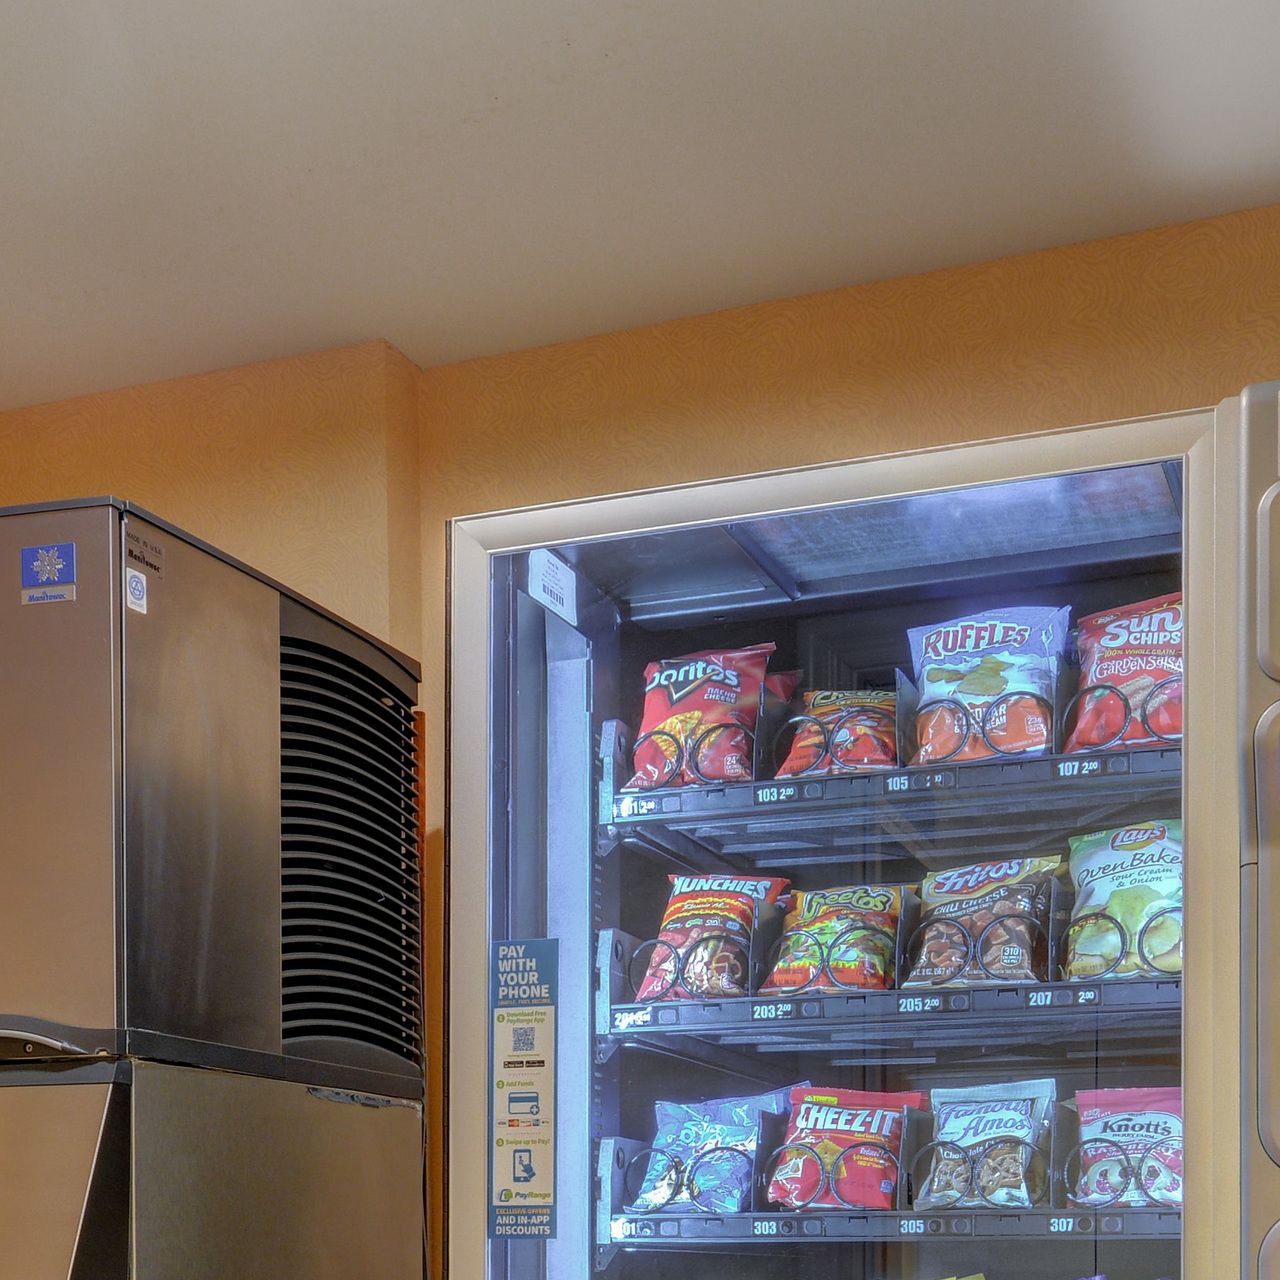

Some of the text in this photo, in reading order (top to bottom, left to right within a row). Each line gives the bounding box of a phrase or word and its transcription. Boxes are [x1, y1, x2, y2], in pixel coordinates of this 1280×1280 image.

[923, 620, 1031, 660] RUFFLES
[1128, 631, 1181, 645] CHIPS
[1057, 761, 1098, 776] 107 2.00
[886, 777, 908, 790] 105
[757, 787, 794, 802] 103 2.00
[1129, 848, 1182, 868] Bake
[934, 858, 1026, 894] Fritos
[1129, 876, 1163, 885] Onion
[933, 887, 1009, 915] CHILI CHEESE
[498, 945, 526, 958] PAY
[498, 958, 536, 972] WITH
[498, 972, 539, 985] YOUR
[498, 985, 550, 999] PHONE
[1029, 991, 1095, 1006] 207 2.00
[753, 1003, 792, 1019] 203 2.00
[899, 998, 940, 1012] 205 2.00
[796, 1103, 901, 1137] CHEEZ-IT
[939, 1100, 1031, 1130] Famous
[951, 1115, 1032, 1142] Amos
[1100, 1117, 1172, 1136] Knott's
[515, 1191, 552, 1200] PayRange
[496, 1215, 550, 1224] AND IN-APP
[900, 1219, 924, 1233] 305
[1049, 1218, 1074, 1232] 307
[496, 1226, 551, 1235] DISCOUNTS
[754, 1222, 777, 1235] 303
